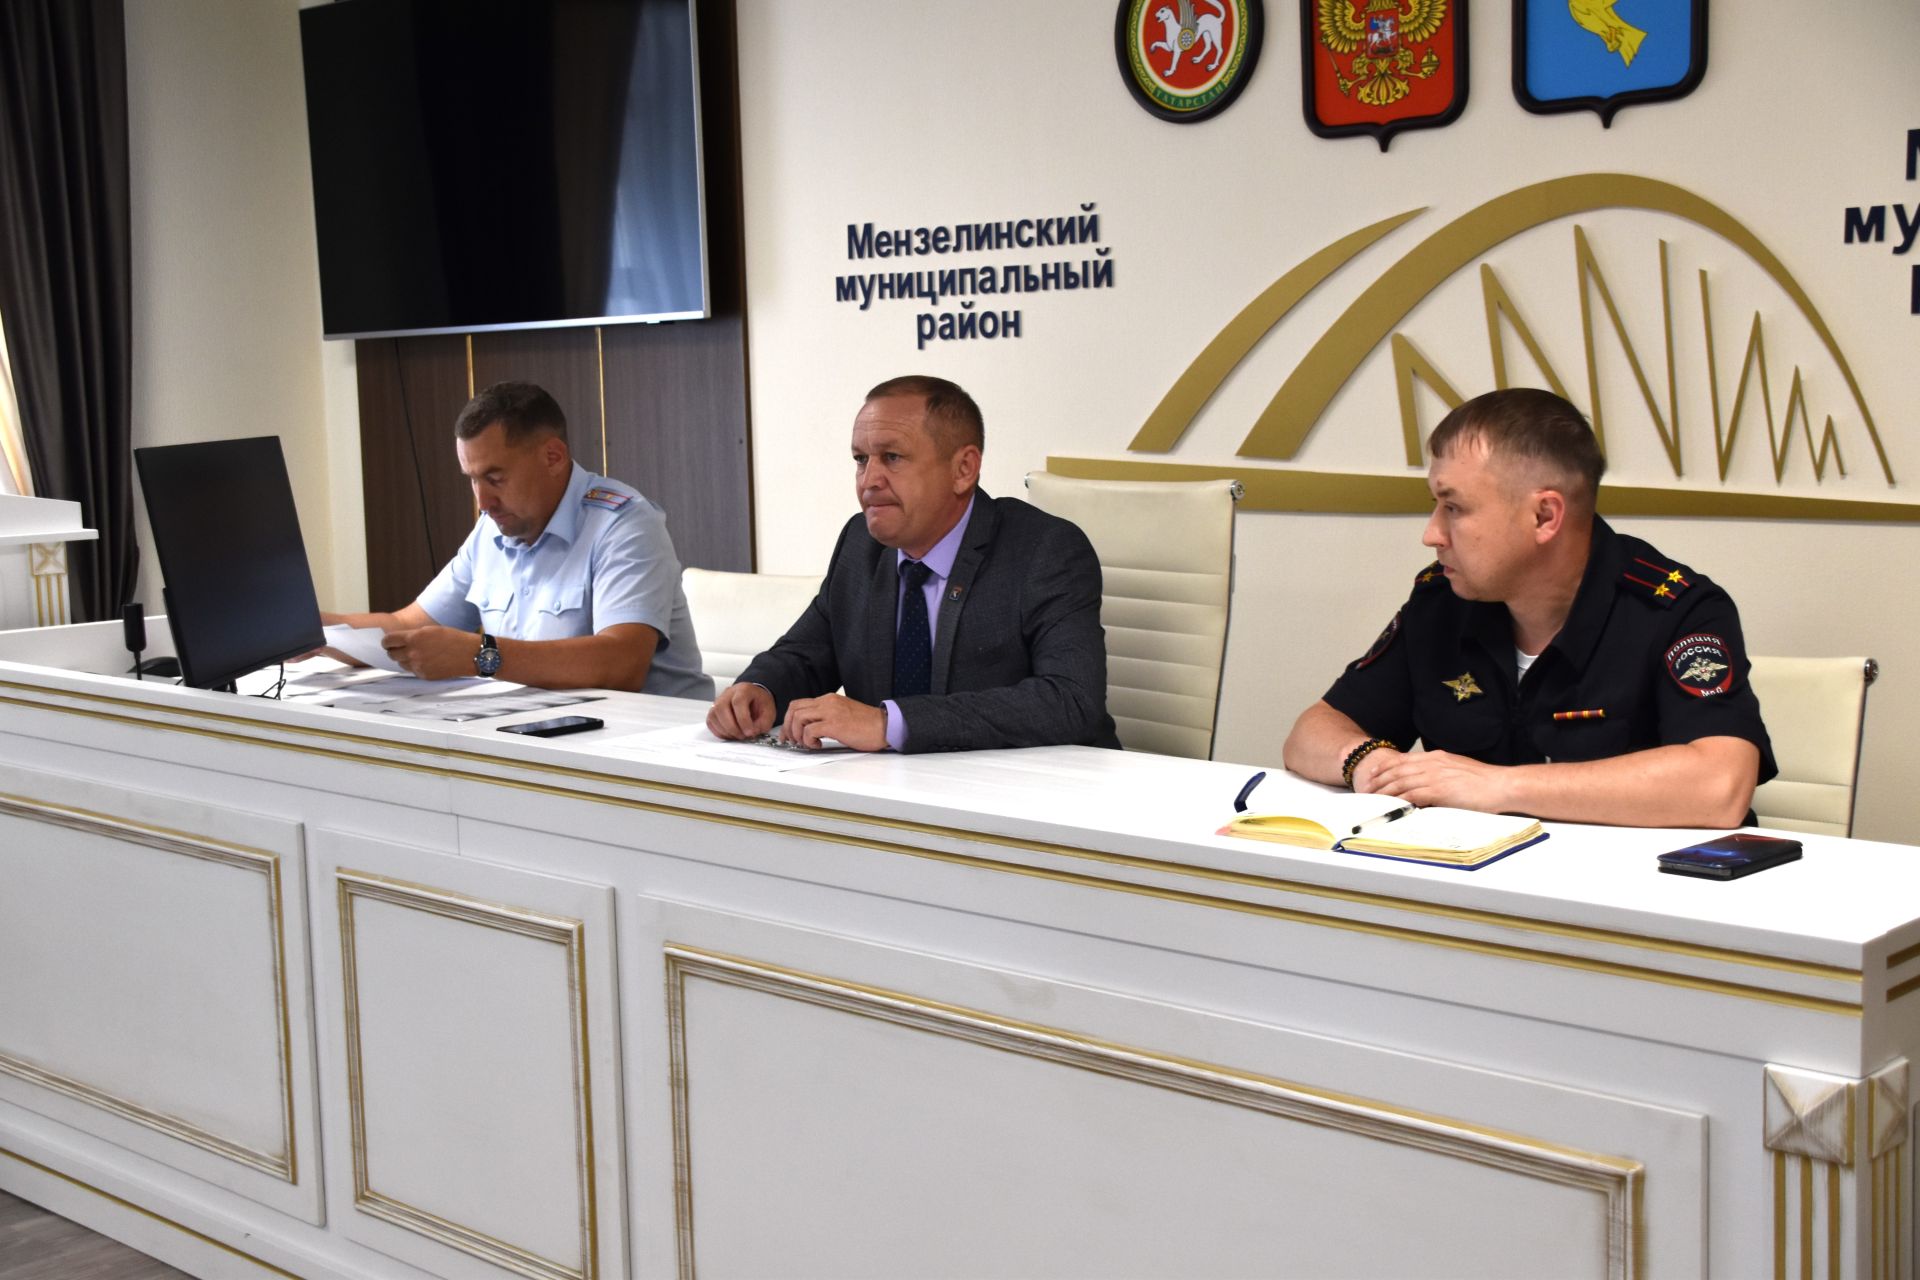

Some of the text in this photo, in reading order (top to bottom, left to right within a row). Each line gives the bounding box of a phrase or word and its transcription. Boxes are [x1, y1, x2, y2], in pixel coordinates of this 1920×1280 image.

[1155, 82, 1225, 108] ТАТАРСТАН
[847, 202, 1099, 260] Мензелинский
[836, 247, 1115, 310] муниципальный
[917, 301, 1022, 350] район
[1667, 635, 1721, 661] ПОЛИЦИЯ
